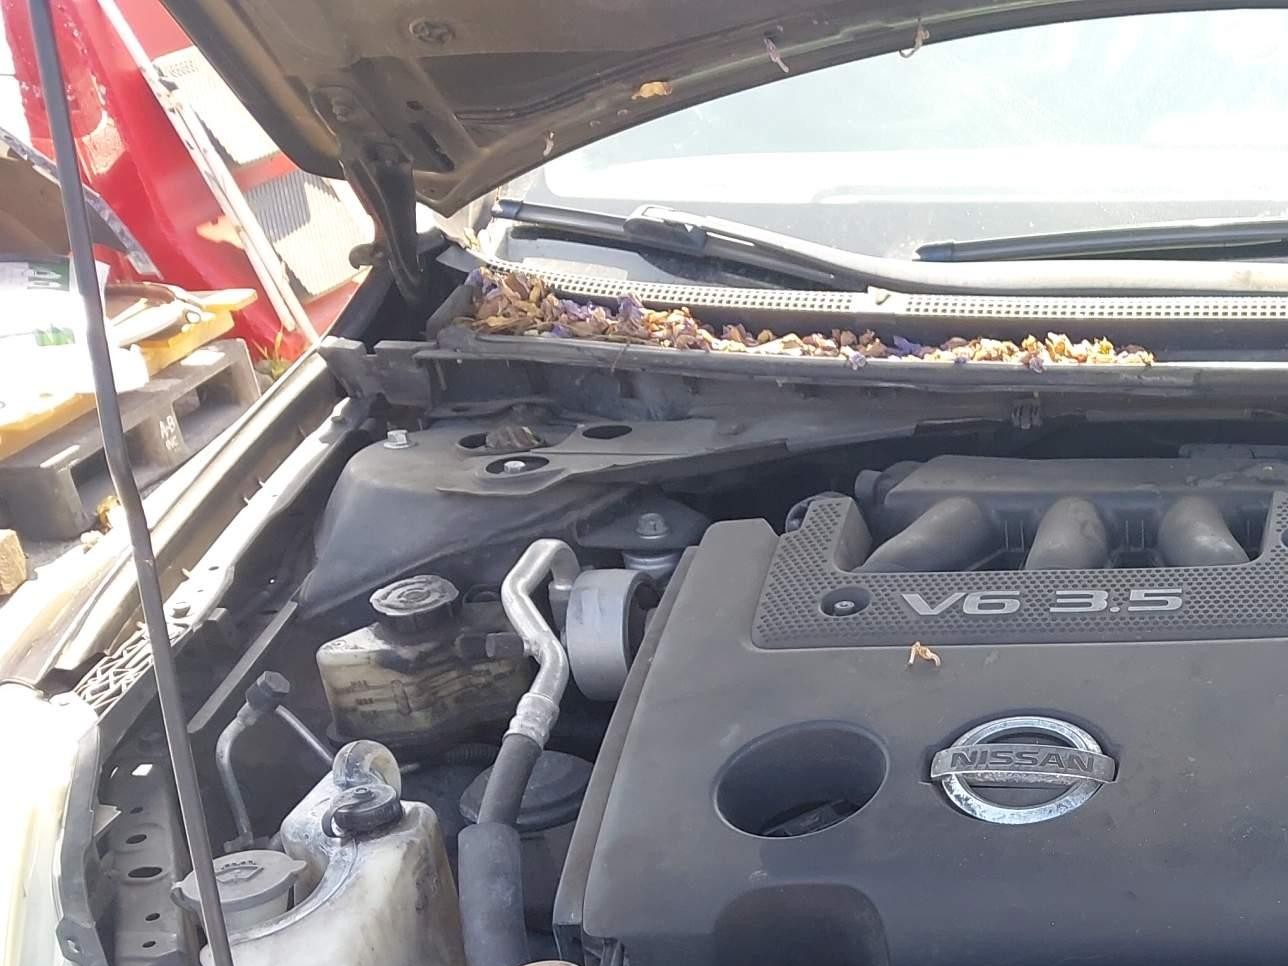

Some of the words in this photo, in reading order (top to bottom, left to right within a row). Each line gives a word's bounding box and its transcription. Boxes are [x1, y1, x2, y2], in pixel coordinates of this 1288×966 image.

[901, 590, 1021, 616] V6
[1049, 588, 1184, 613] 3.5
[950, 749, 1095, 773] NISSAN
